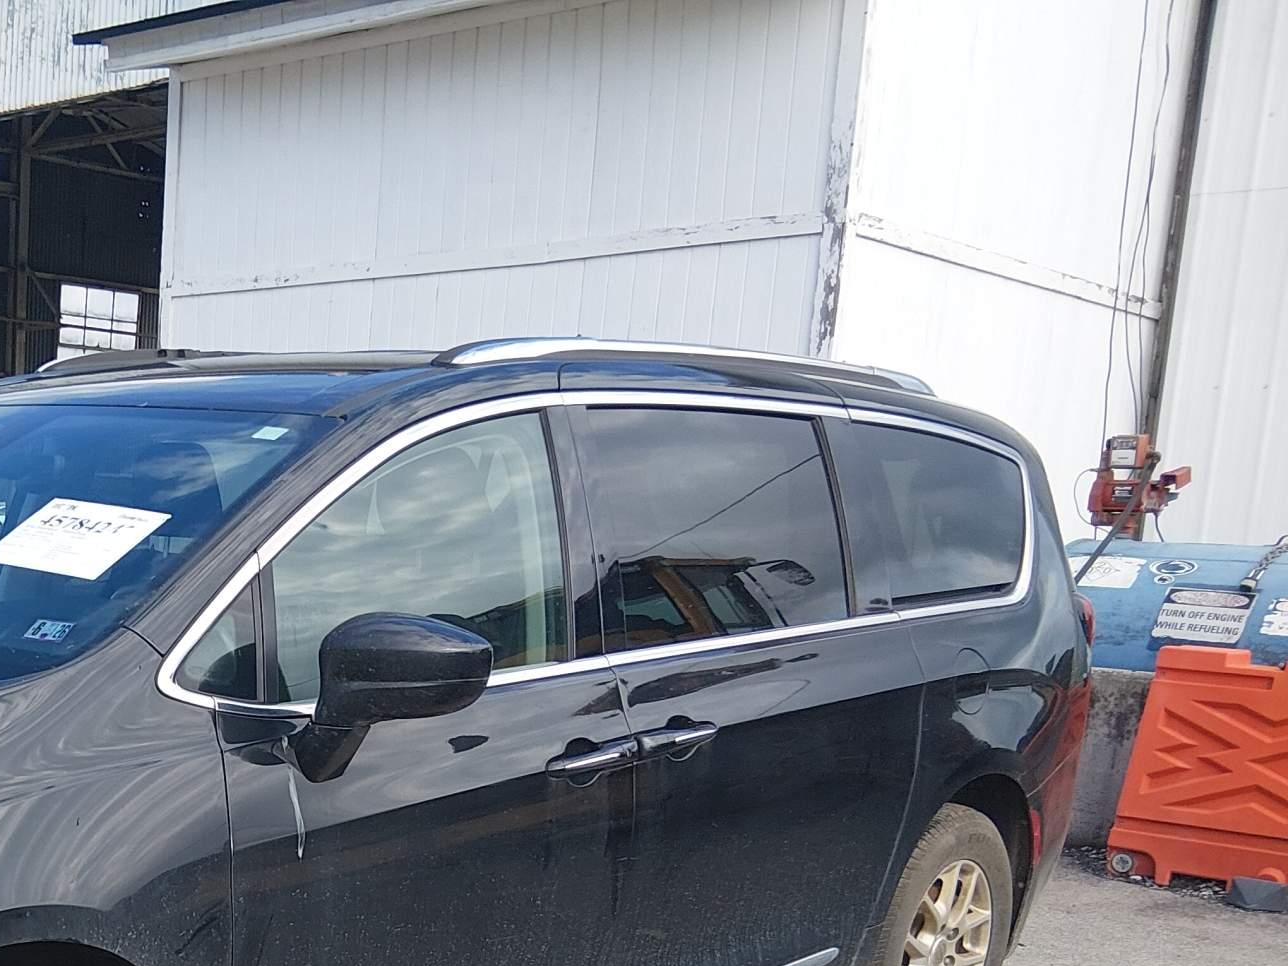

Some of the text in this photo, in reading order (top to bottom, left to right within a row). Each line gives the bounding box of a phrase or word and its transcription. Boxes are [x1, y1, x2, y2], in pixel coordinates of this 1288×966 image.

[1160, 608, 1245, 624] TURN OFF ENGINE
[1156, 621, 1240, 636] WHILE REFUELING
